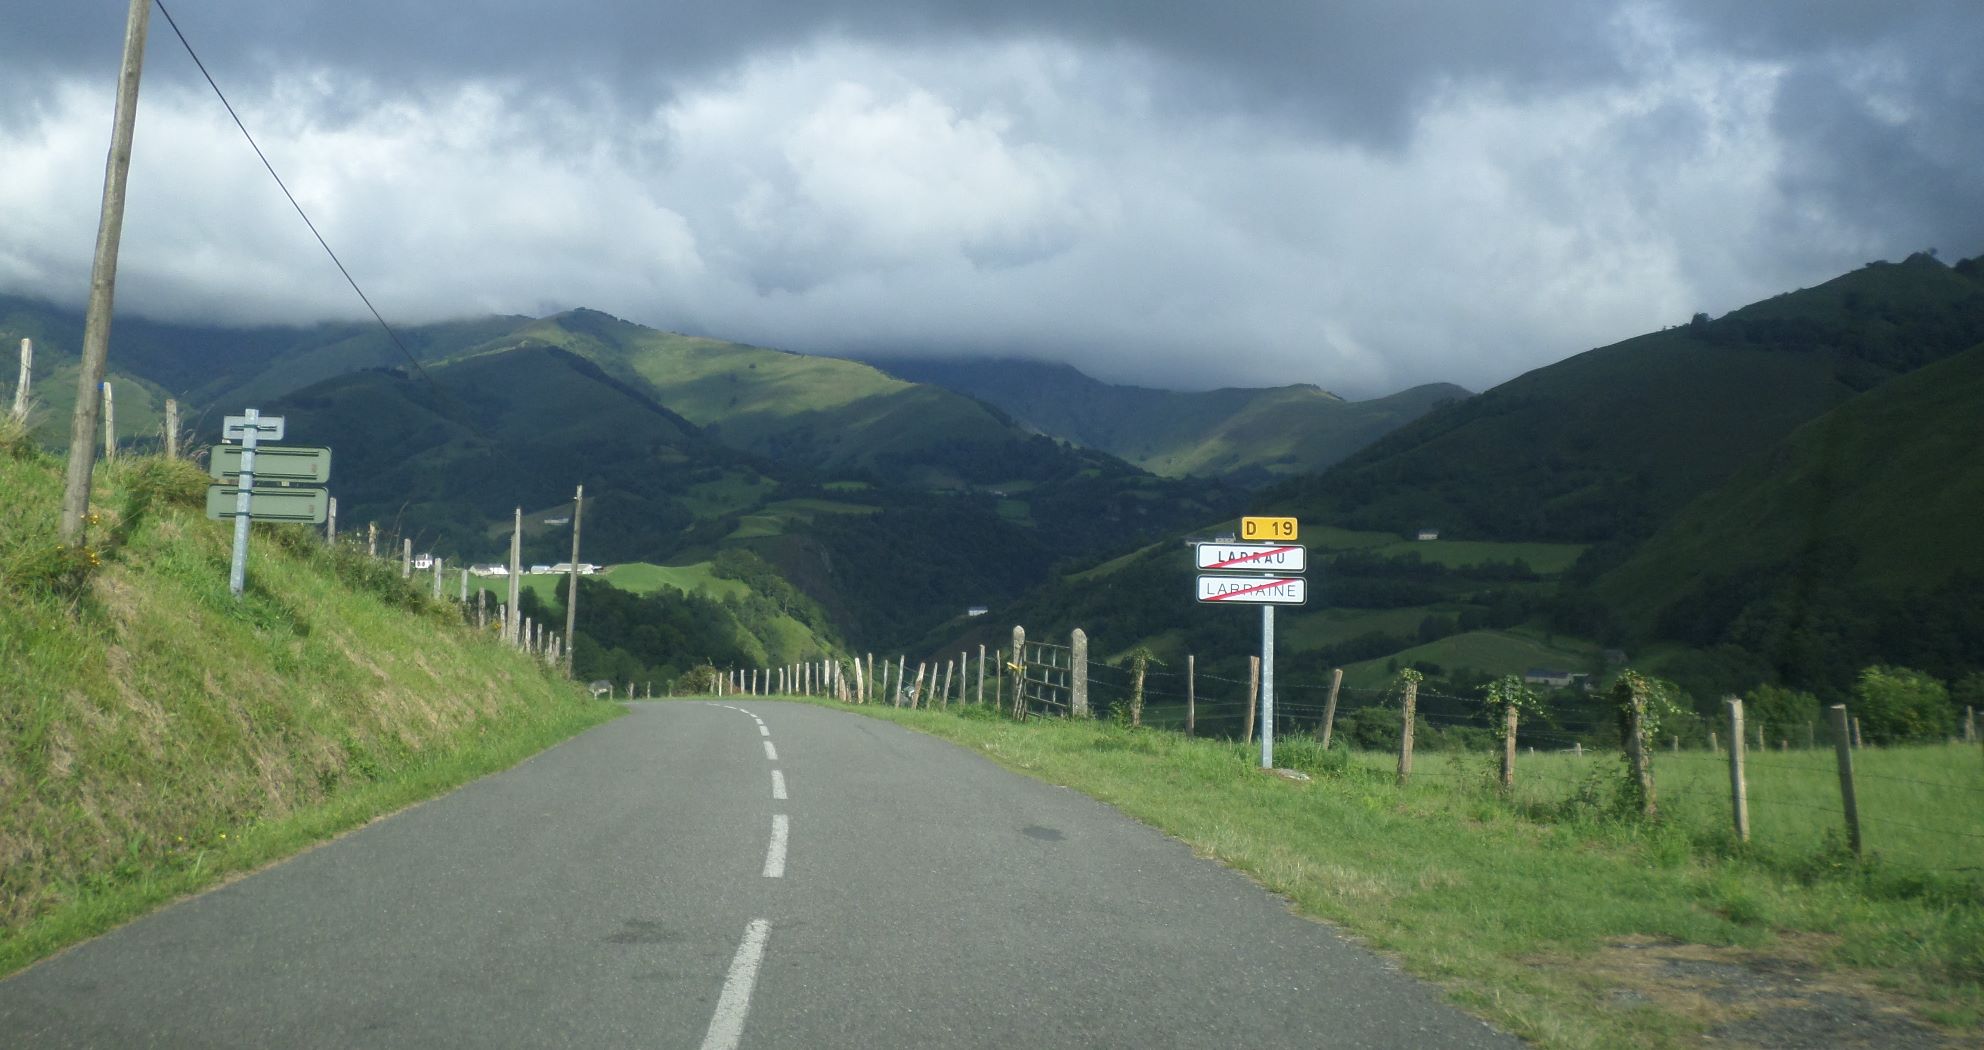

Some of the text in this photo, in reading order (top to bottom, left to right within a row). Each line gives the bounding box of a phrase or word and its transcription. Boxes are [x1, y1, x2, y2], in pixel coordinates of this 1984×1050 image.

[1246, 521, 1293, 536] D 19
[1218, 550, 1285, 564] LARRAU
[1207, 582, 1296, 597] LARRAINE
